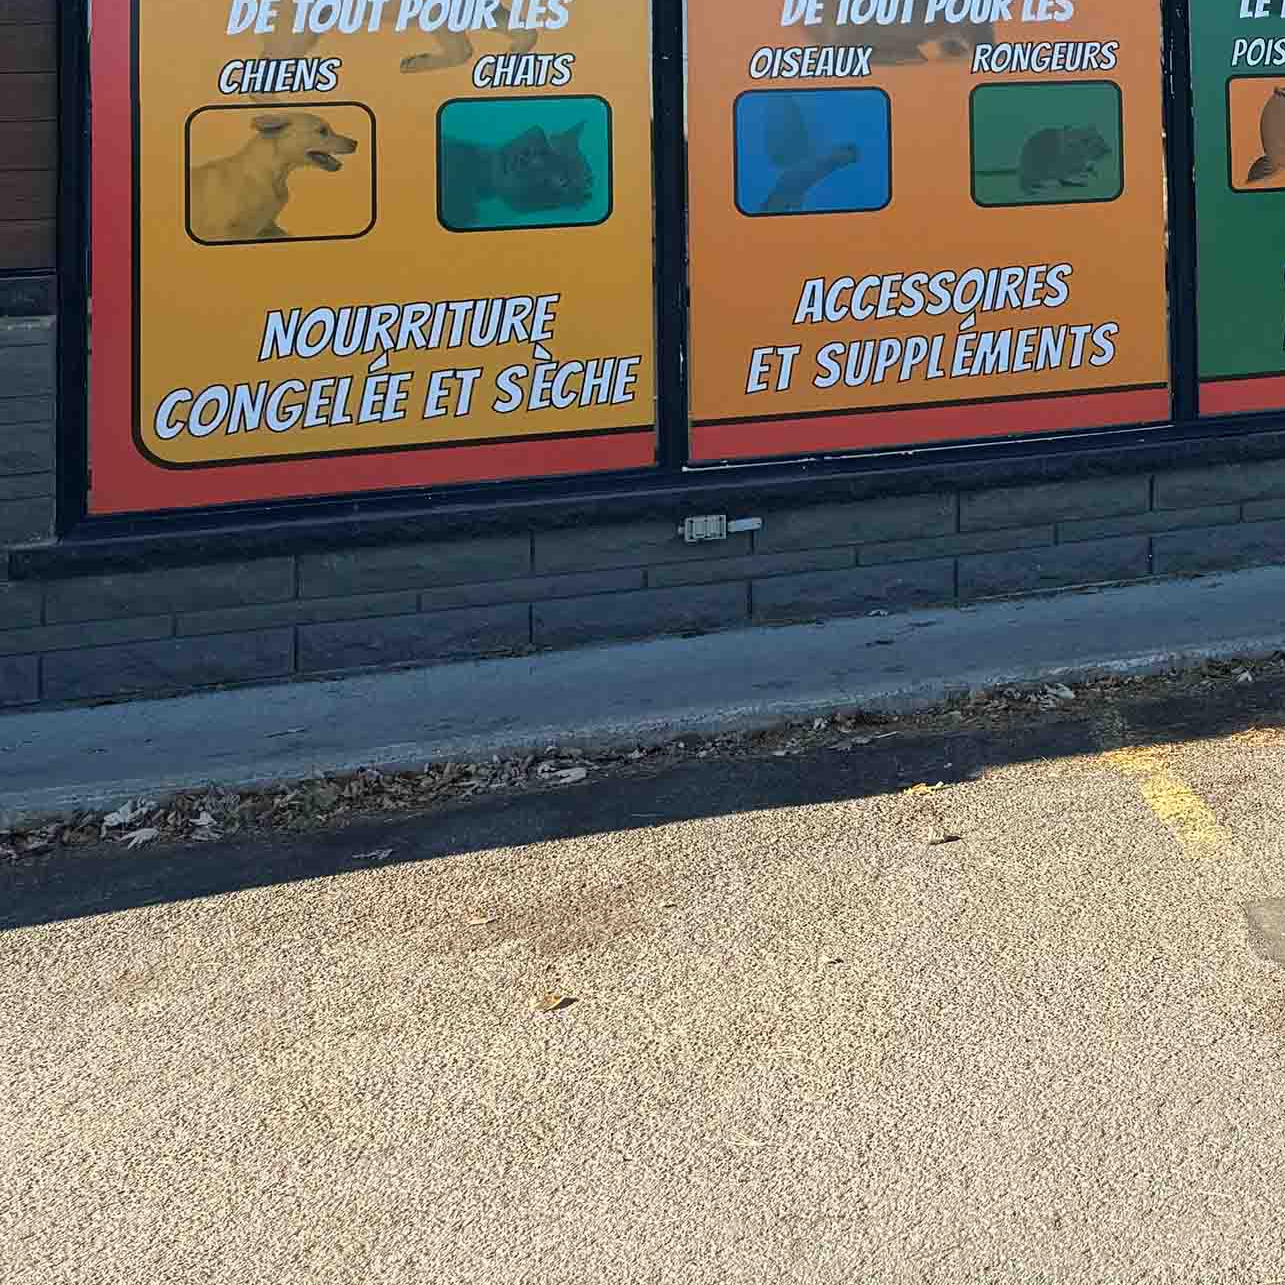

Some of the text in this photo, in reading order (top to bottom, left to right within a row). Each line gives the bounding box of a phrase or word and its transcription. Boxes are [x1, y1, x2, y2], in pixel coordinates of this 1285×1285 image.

[218, 57, 342, 95] CHIENS
[471, 52, 575, 88] CHATS
[747, 45, 873, 80] OISEAUX
[970, 41, 1120, 75] RONGEURS
[792, 261, 1074, 326] ACCESSOIRES
[258, 292, 560, 363] NOURRITURE
[744, 313, 1120, 395] ET SUPPLÉMENTS
[153, 342, 642, 439] CONGELÉE ET SÈCHE
